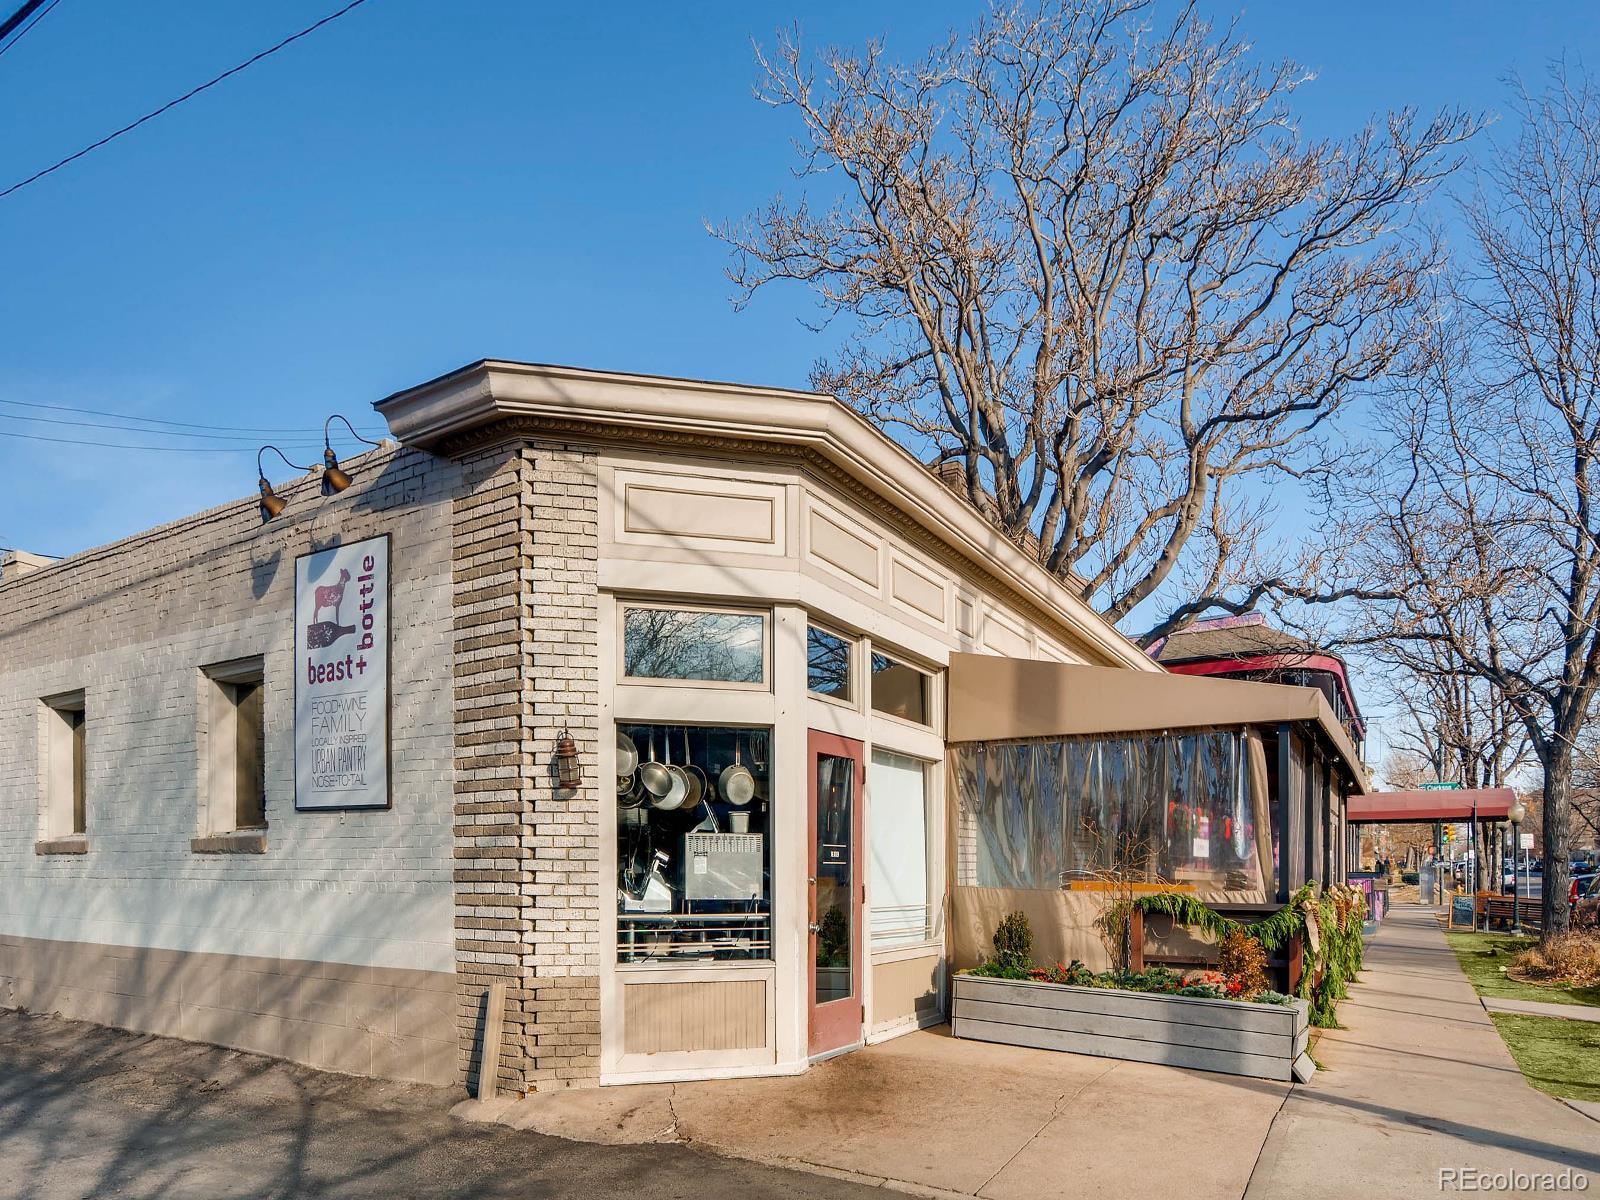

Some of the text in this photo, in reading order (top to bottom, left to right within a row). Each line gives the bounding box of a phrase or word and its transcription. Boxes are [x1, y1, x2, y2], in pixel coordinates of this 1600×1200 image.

[357, 555, 375, 651] bottle
[312, 712, 367, 735] FAMILY
[312, 736, 338, 747] LOCALLY
[312, 745, 367, 774] URBAN PANTRY
